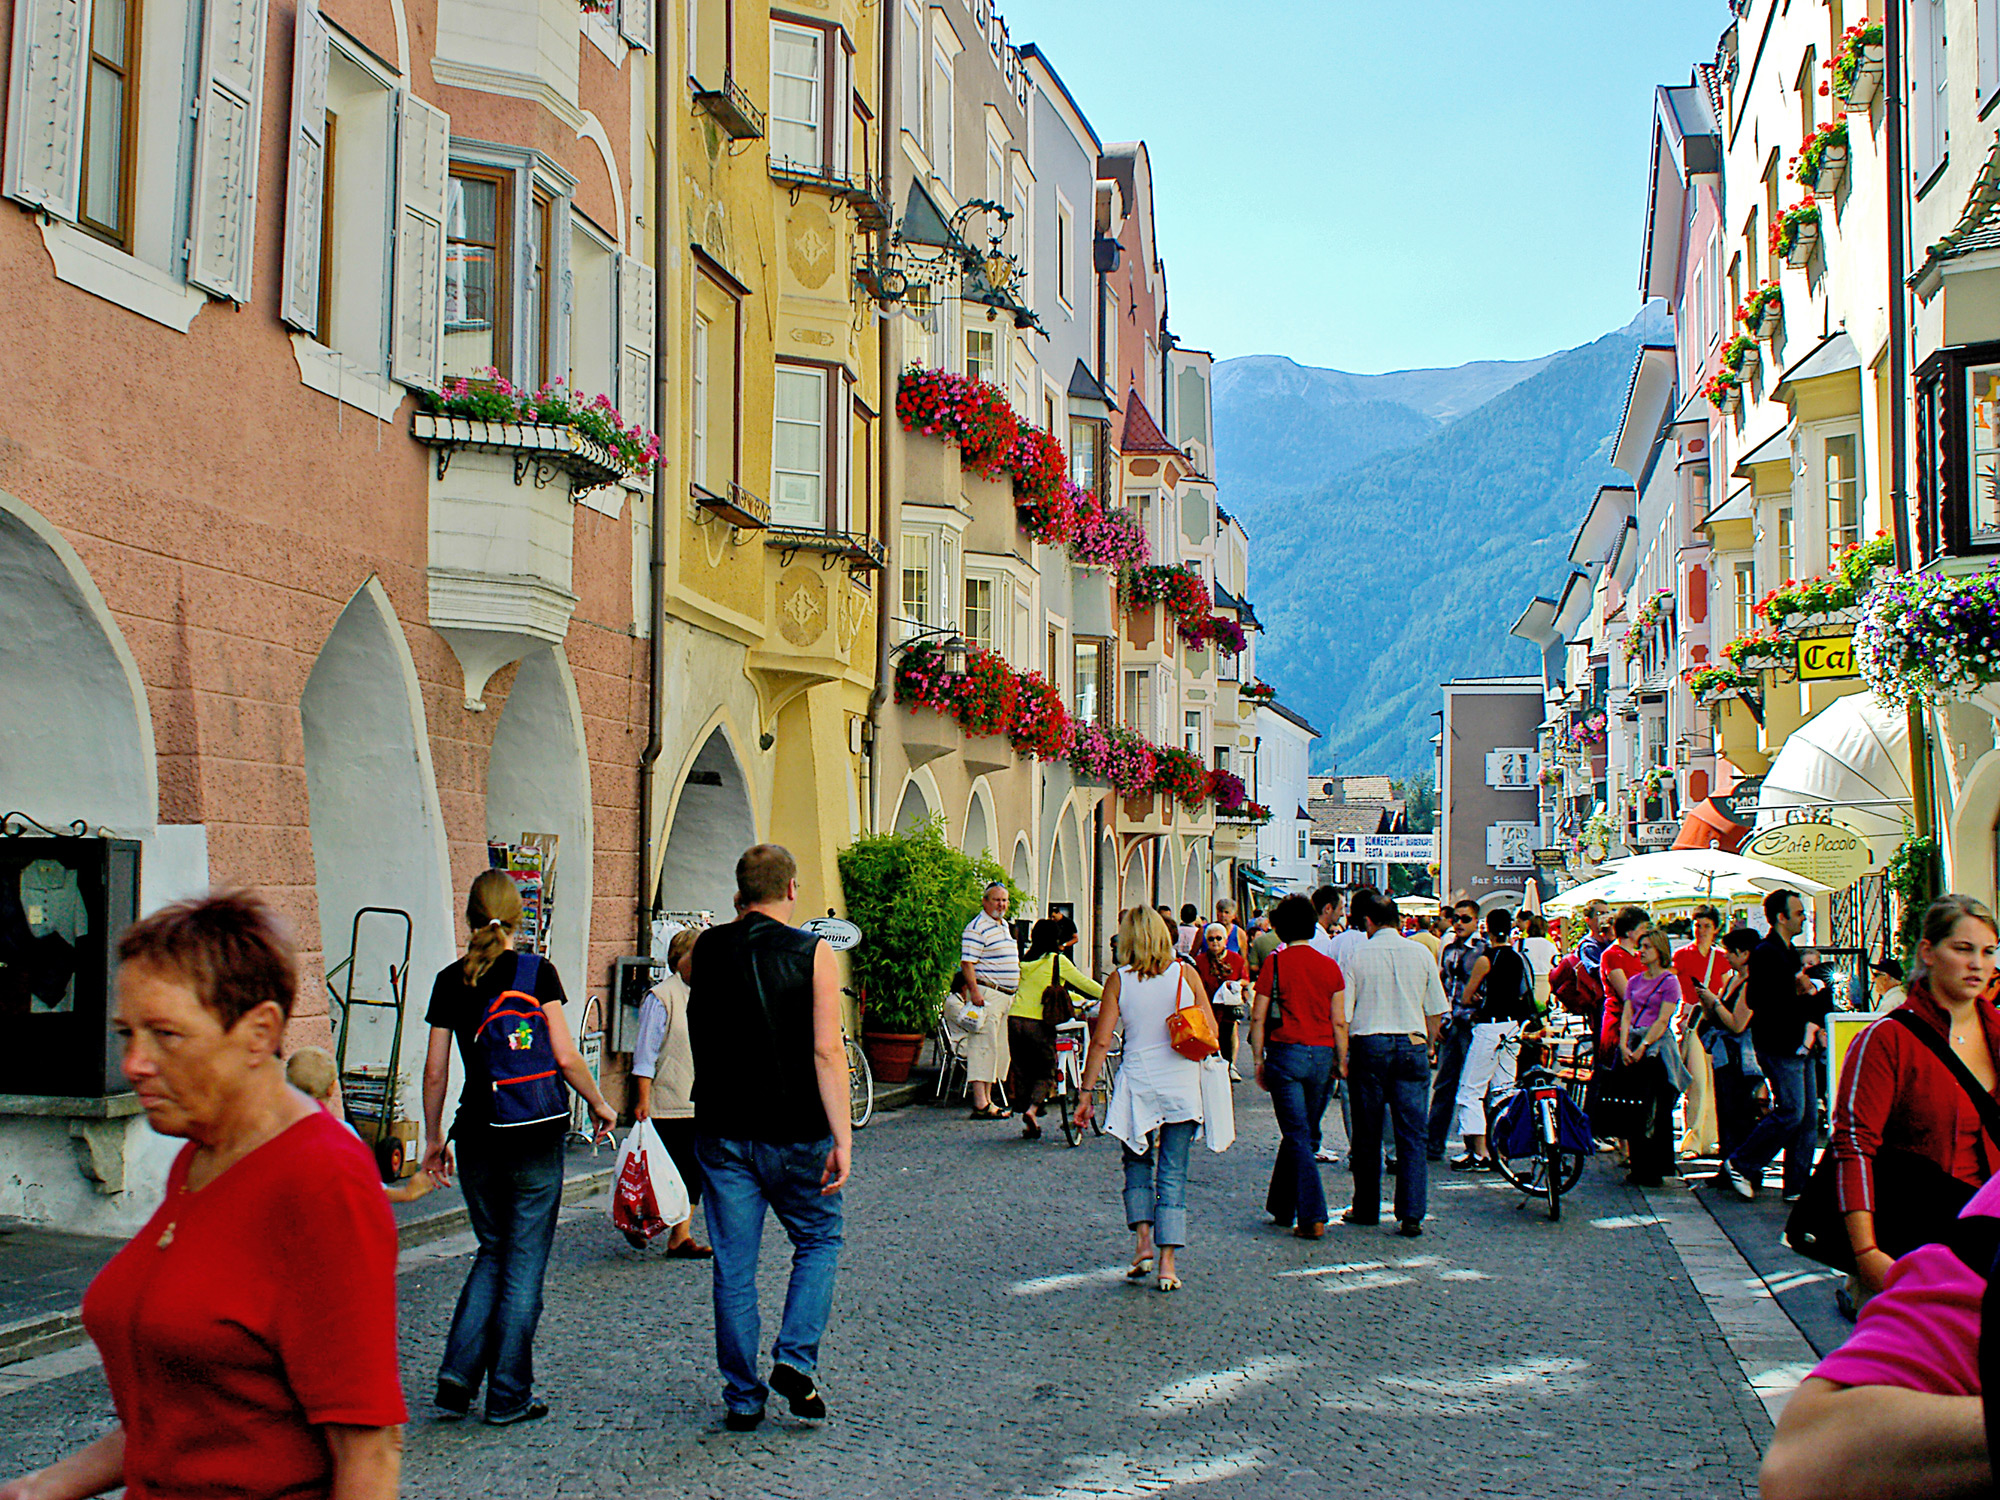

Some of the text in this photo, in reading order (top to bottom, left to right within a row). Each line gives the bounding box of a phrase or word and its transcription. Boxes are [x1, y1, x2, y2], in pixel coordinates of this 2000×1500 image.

[1814, 833, 1857, 852] Piccolo
[1365, 847, 1383, 857] FESTA
[1471, 875, 1490, 886] Bar
